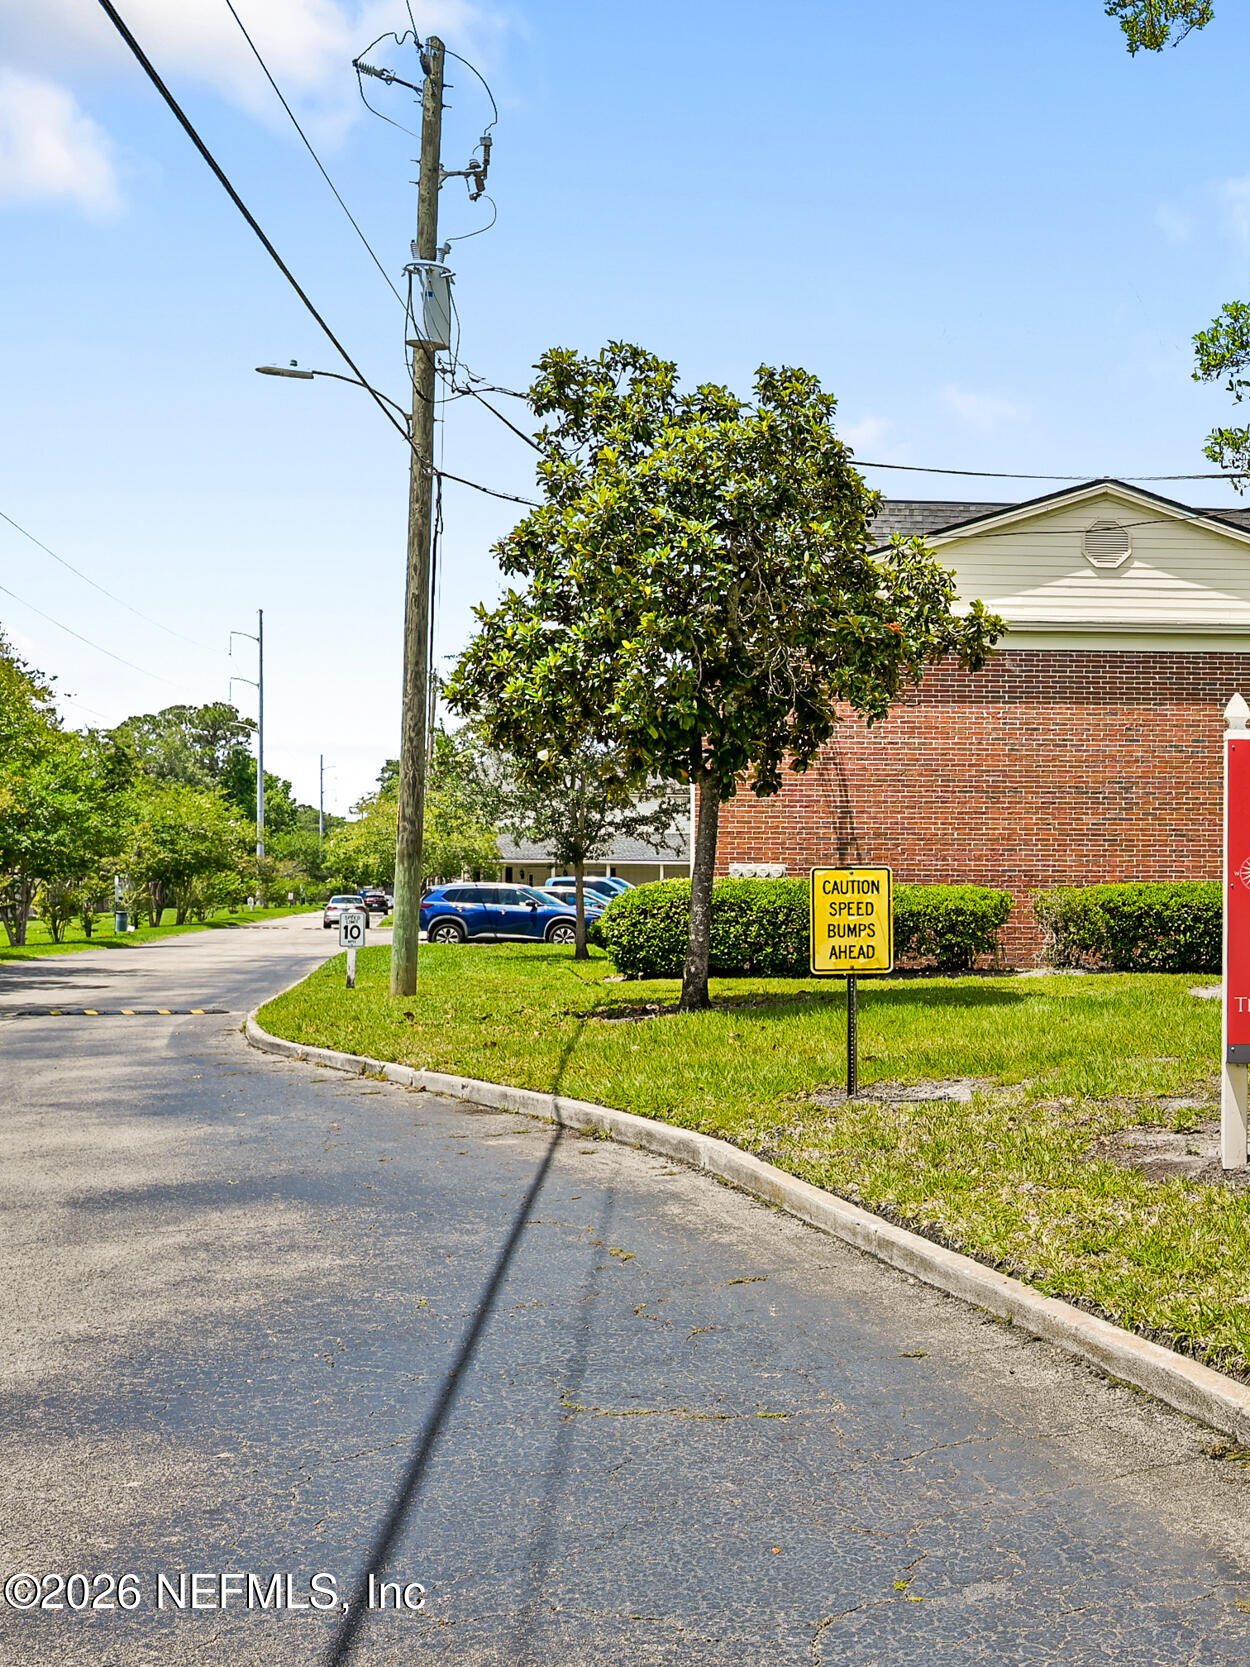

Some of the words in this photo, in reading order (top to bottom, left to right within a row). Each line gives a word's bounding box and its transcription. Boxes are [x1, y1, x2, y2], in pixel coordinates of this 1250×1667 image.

[823, 880, 879, 894] CAUTION
[829, 902, 873, 916] SPEED
[344, 925, 361, 939] 10
[828, 923, 875, 938] BUMPS
[829, 945, 875, 959] AHEAD
